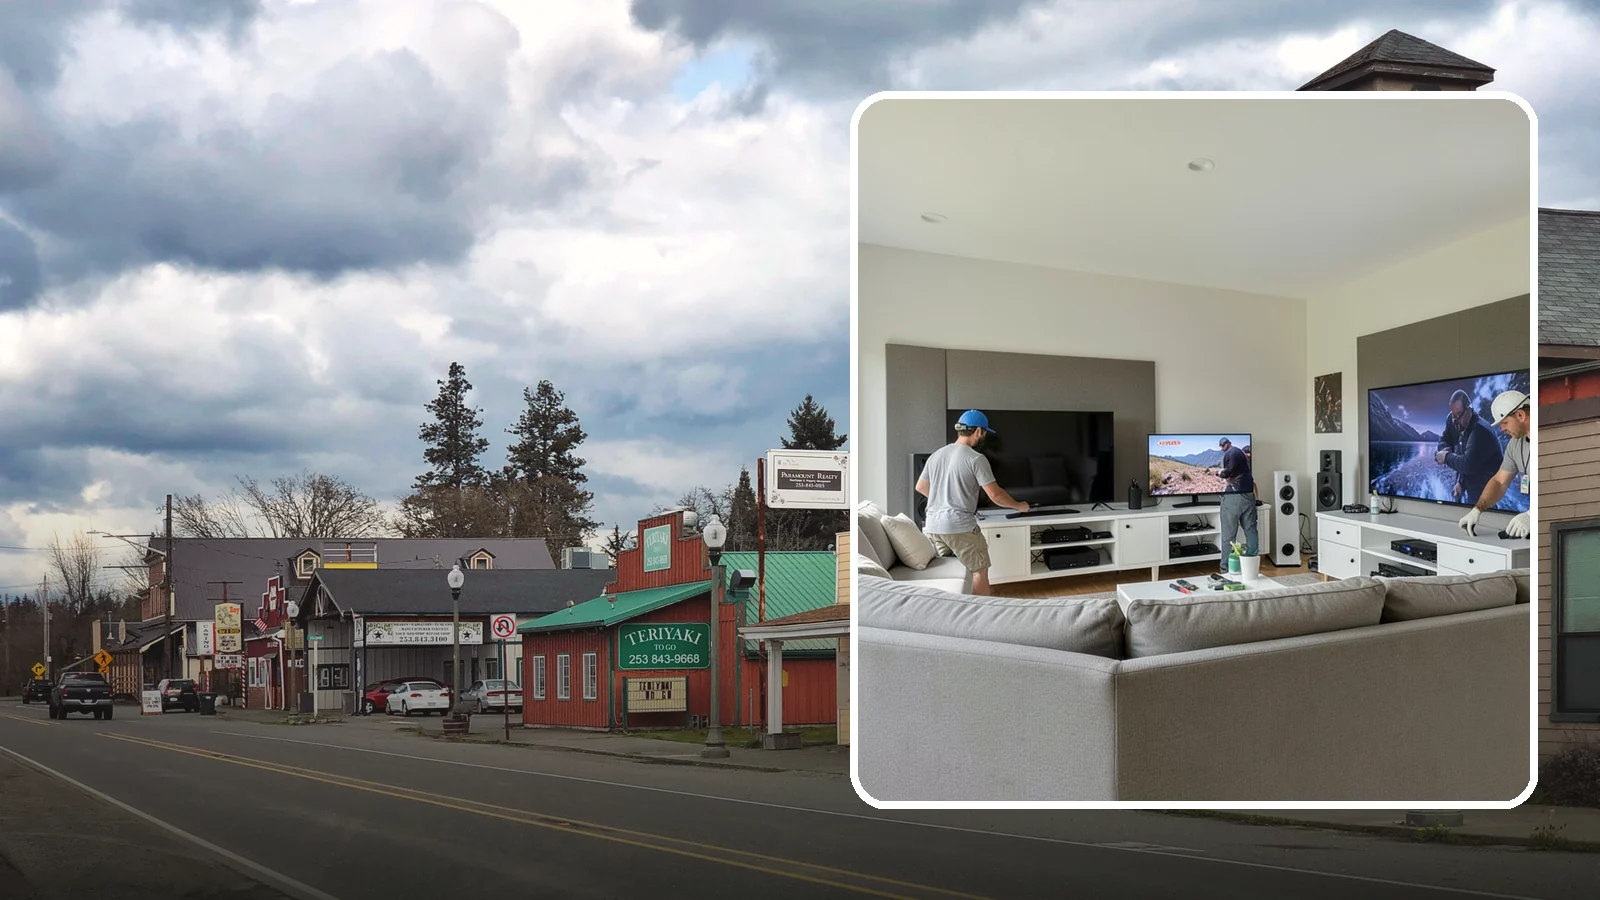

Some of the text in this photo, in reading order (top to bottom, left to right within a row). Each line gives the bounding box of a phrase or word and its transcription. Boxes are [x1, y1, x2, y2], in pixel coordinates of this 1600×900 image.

[781, 471, 815, 479] PARAMOUNT
[624, 627, 702, 646] TERIYAKI
[629, 653, 700, 665] 253 843-9668
[639, 681, 672, 691] TERIYAKI
